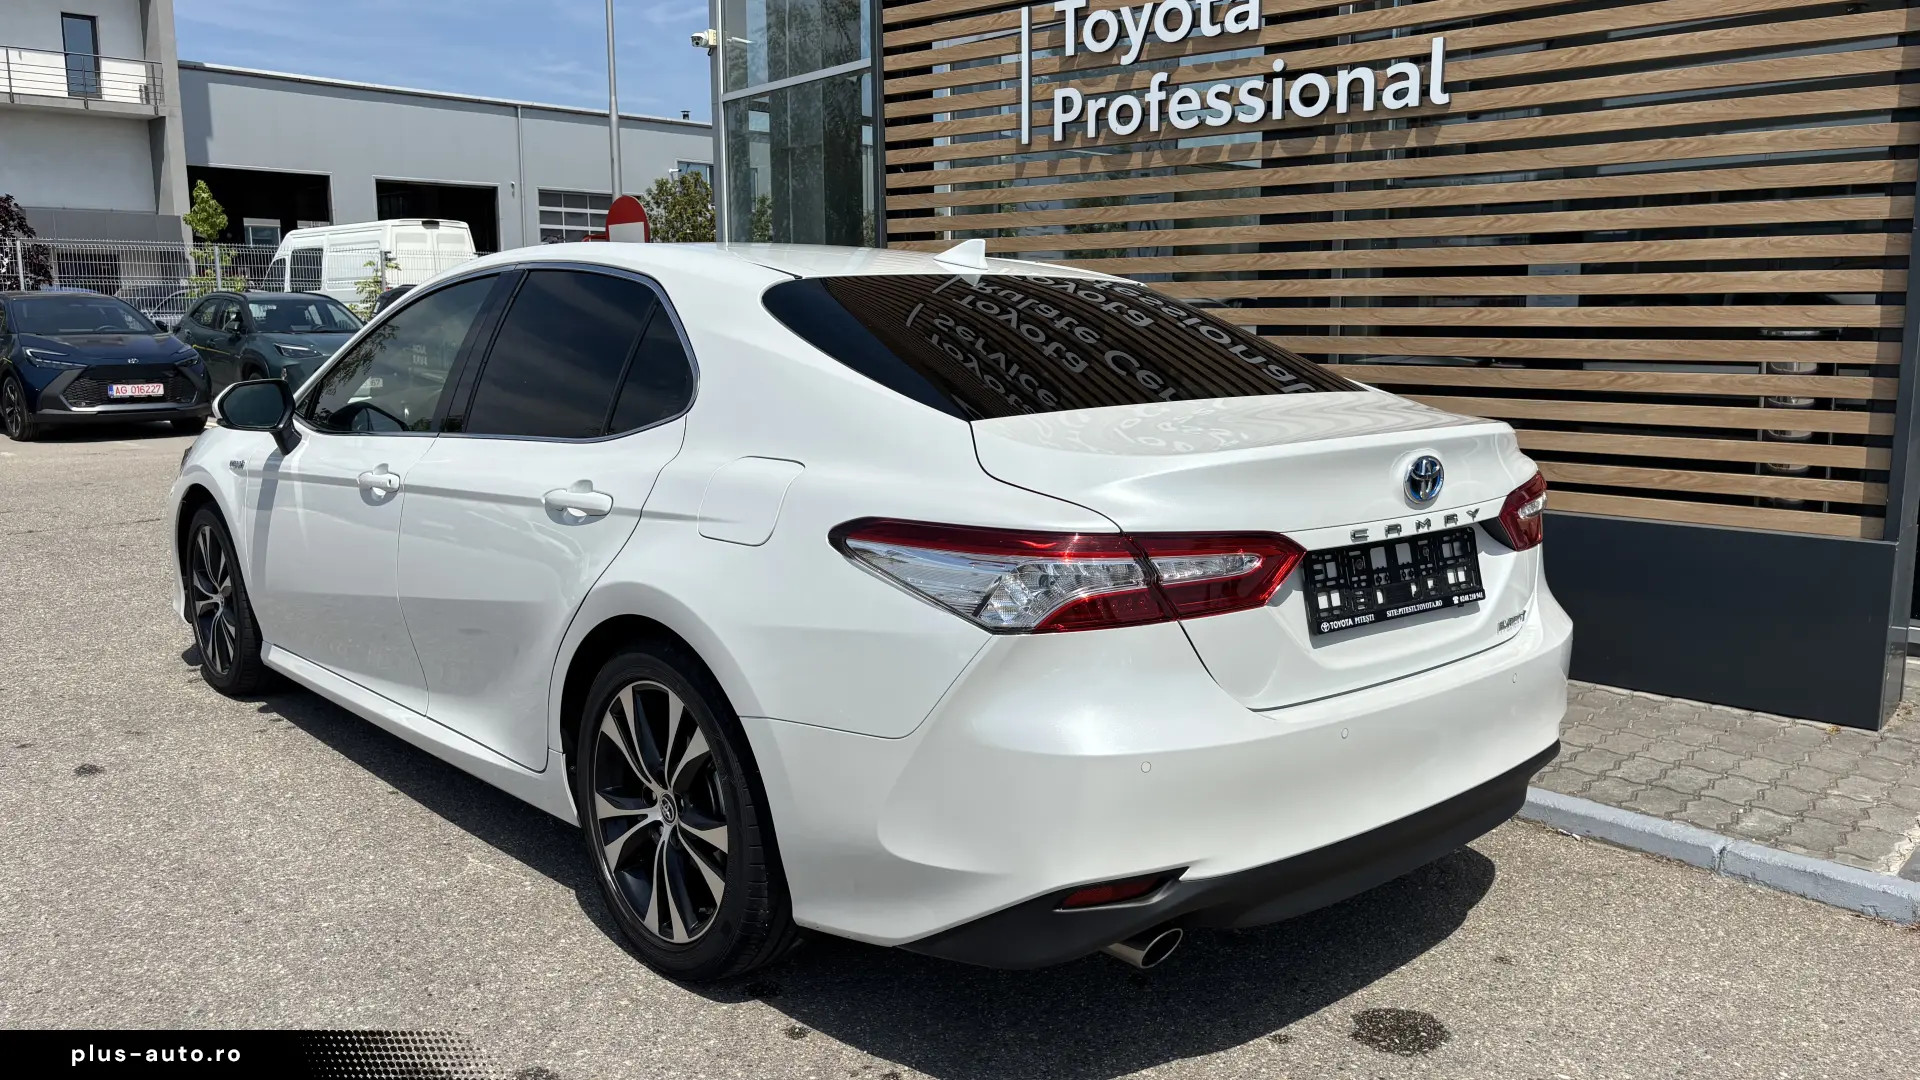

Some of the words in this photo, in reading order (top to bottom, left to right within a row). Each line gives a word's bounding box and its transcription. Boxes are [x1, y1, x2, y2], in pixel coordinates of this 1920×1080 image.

[1054, 0, 1260, 65] Toyota
[1053, 37, 1450, 142] Professional
[115, 385, 128, 395] AG
[130, 384, 161, 395] 016227
[1350, 508, 1480, 542] CAMRY
[1329, 618, 1353, 630] TOYOTA
